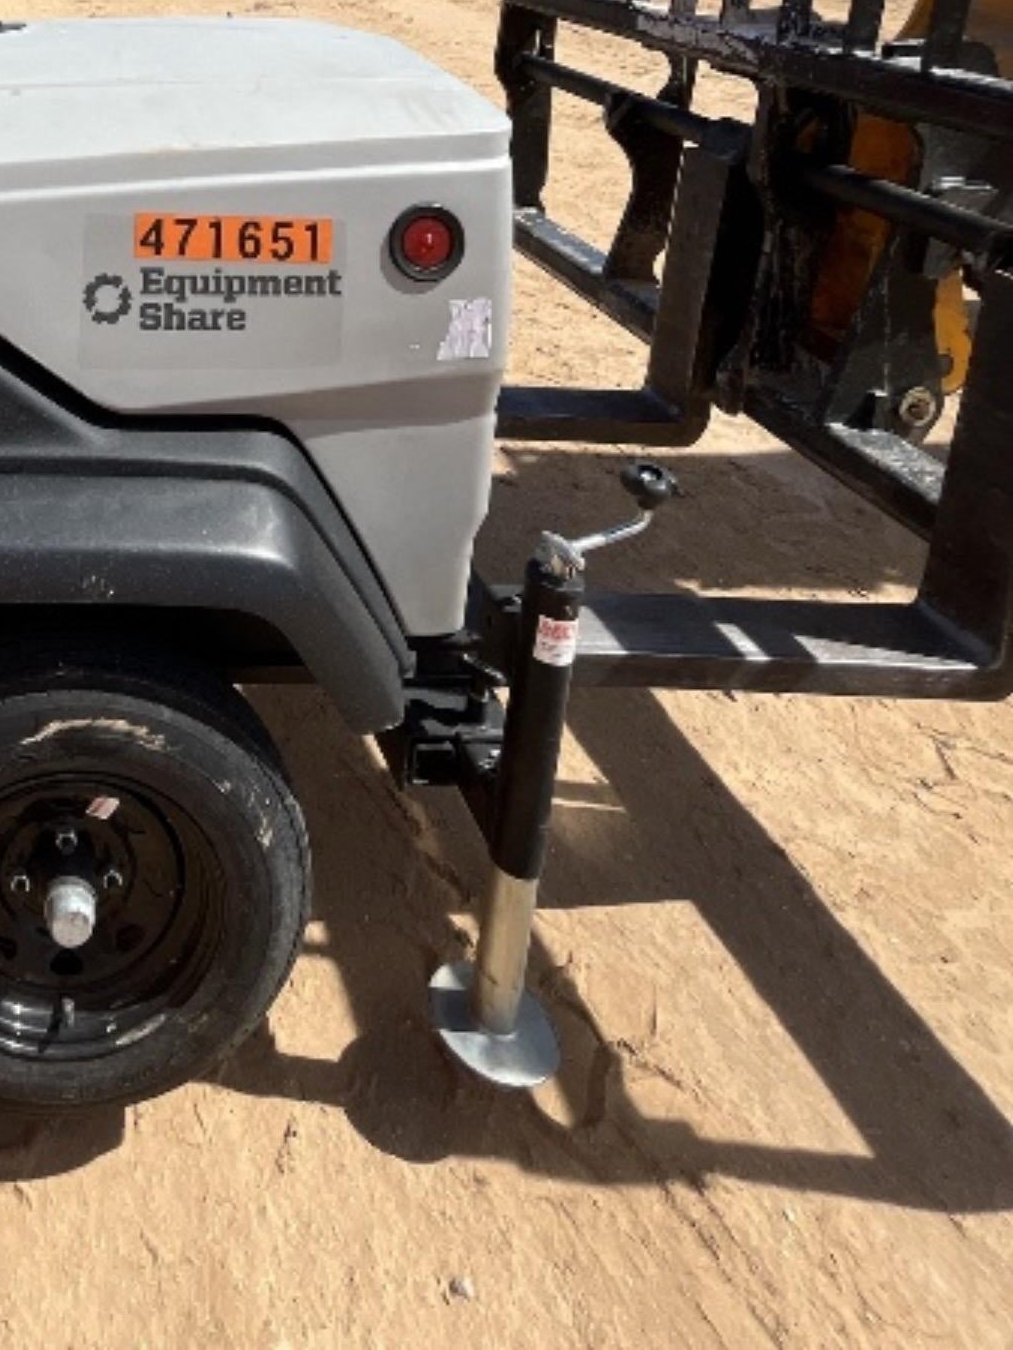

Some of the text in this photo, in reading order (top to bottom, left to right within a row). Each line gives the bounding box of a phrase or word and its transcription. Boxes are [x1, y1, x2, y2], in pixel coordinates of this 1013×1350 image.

[140, 218, 319, 261] 471651
[139, 266, 342, 303] Equipment
[139, 303, 246, 331] Share
